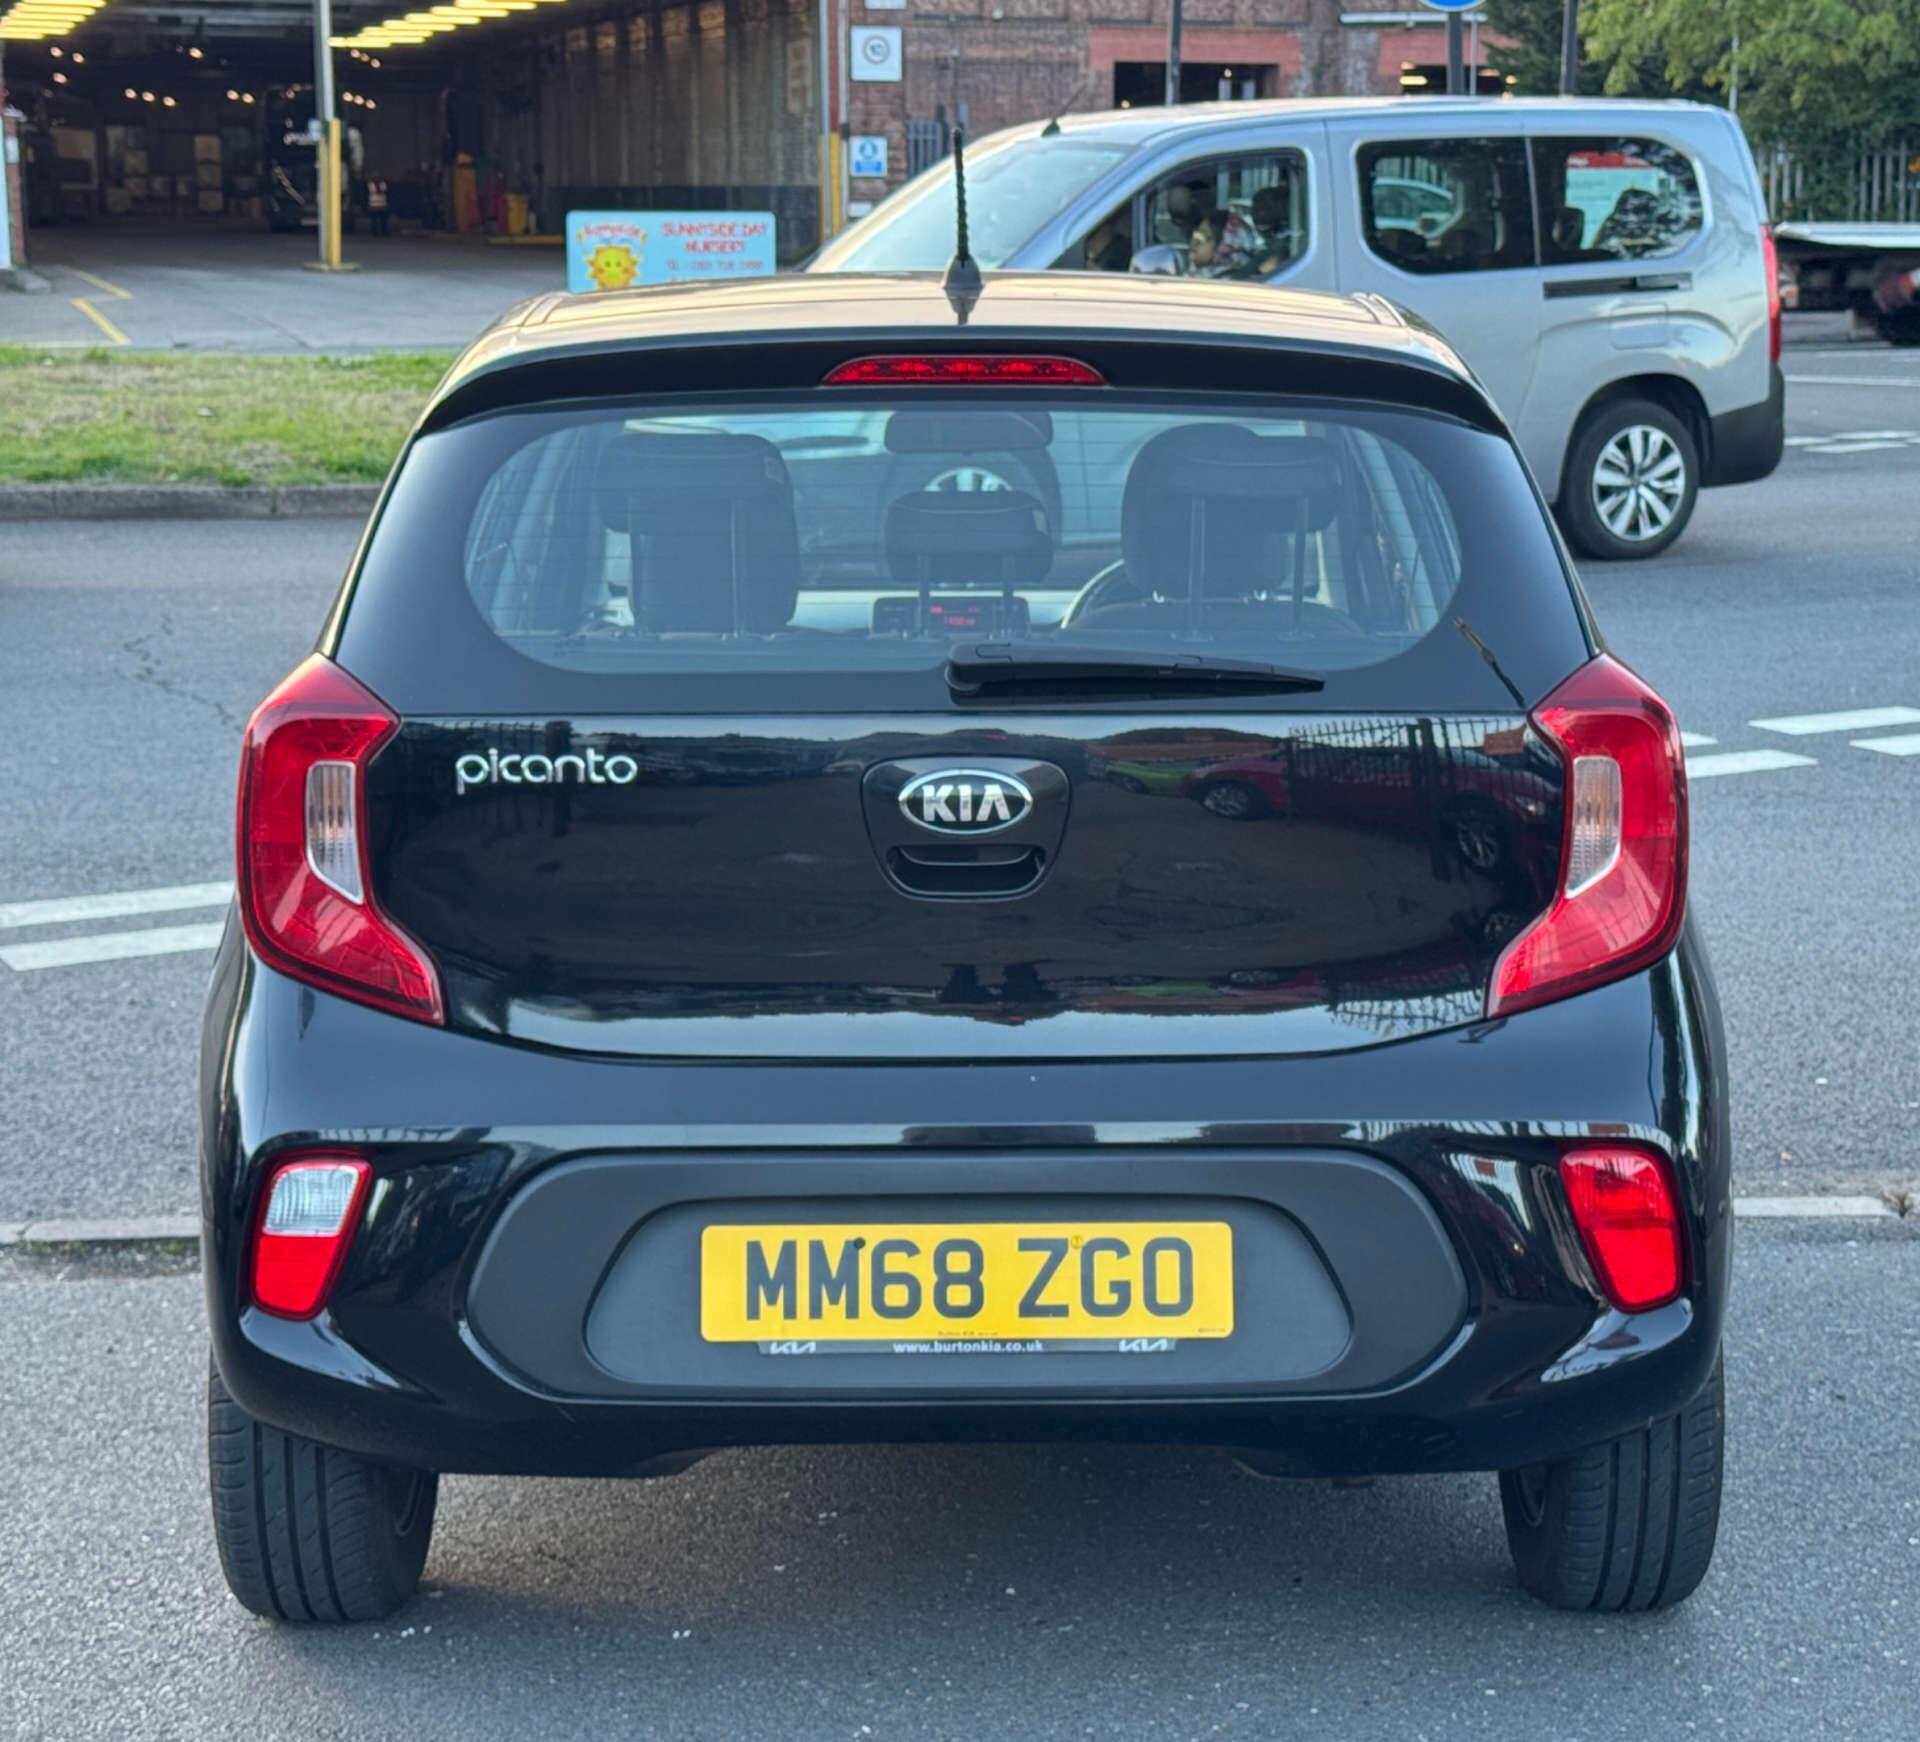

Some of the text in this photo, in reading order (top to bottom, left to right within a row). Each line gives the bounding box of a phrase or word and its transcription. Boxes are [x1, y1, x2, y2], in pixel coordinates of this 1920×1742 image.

[456, 747, 638, 795] picanto
[922, 784, 1011, 822] KIA
[745, 1237, 1194, 1321] MM68 ZGO
[893, 1340, 1044, 1353] www.burtonkia.co.uk
